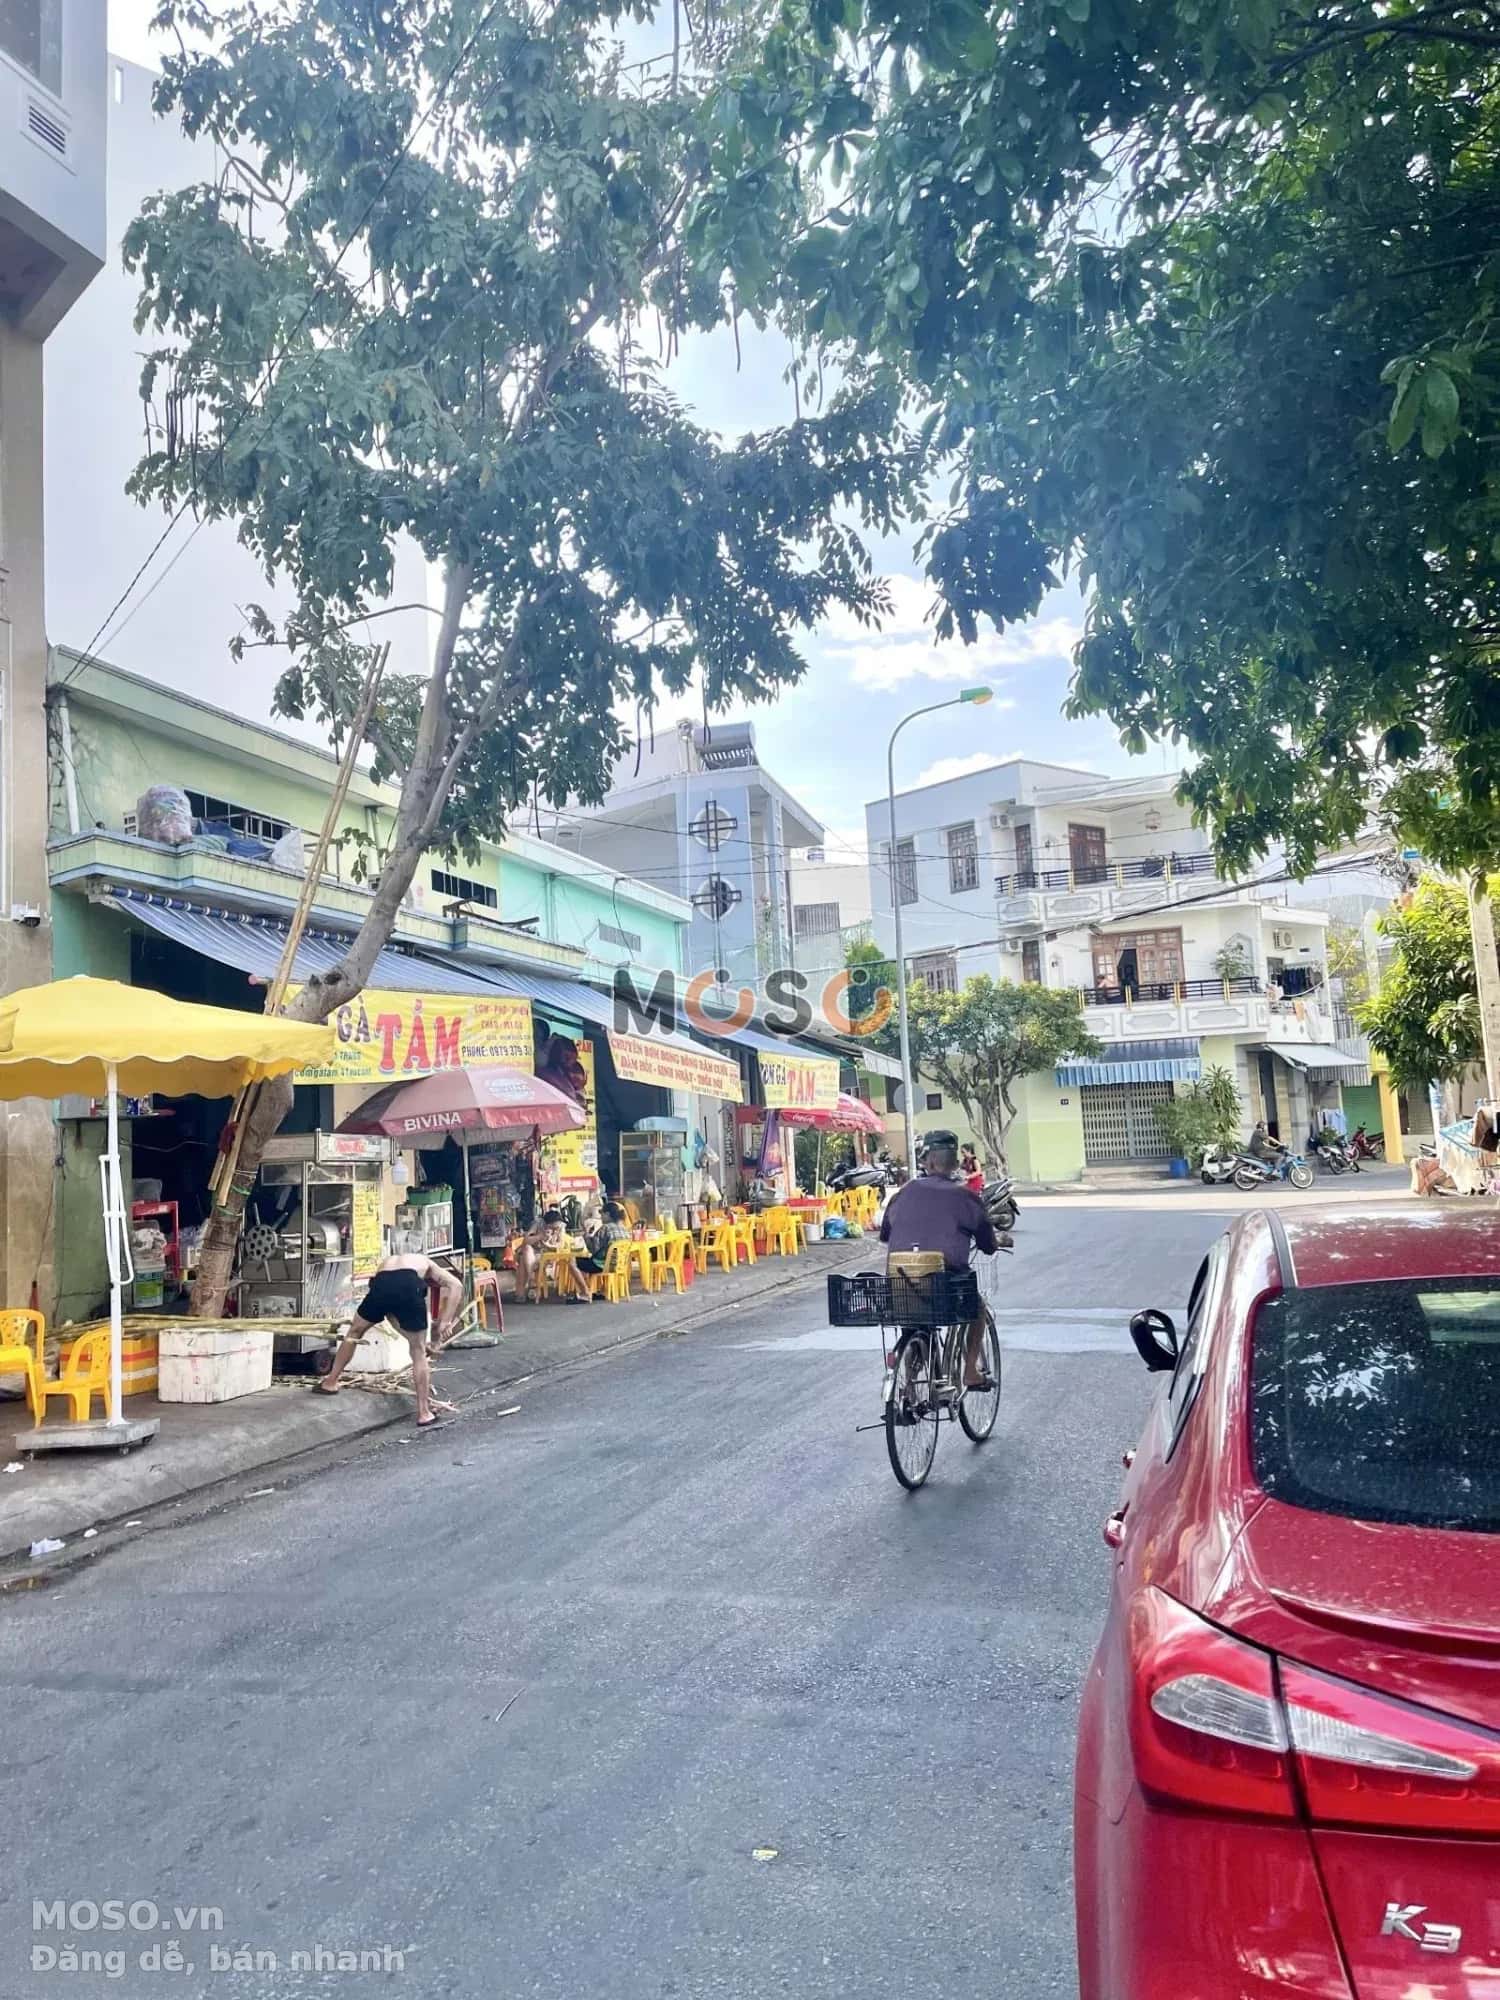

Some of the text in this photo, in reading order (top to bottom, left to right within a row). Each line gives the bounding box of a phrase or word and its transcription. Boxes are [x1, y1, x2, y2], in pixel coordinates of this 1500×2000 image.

[337, 995, 371, 1043] GÀ
[404, 1111, 462, 1131] BIVINA
[1380, 1902, 1462, 1954] K3
